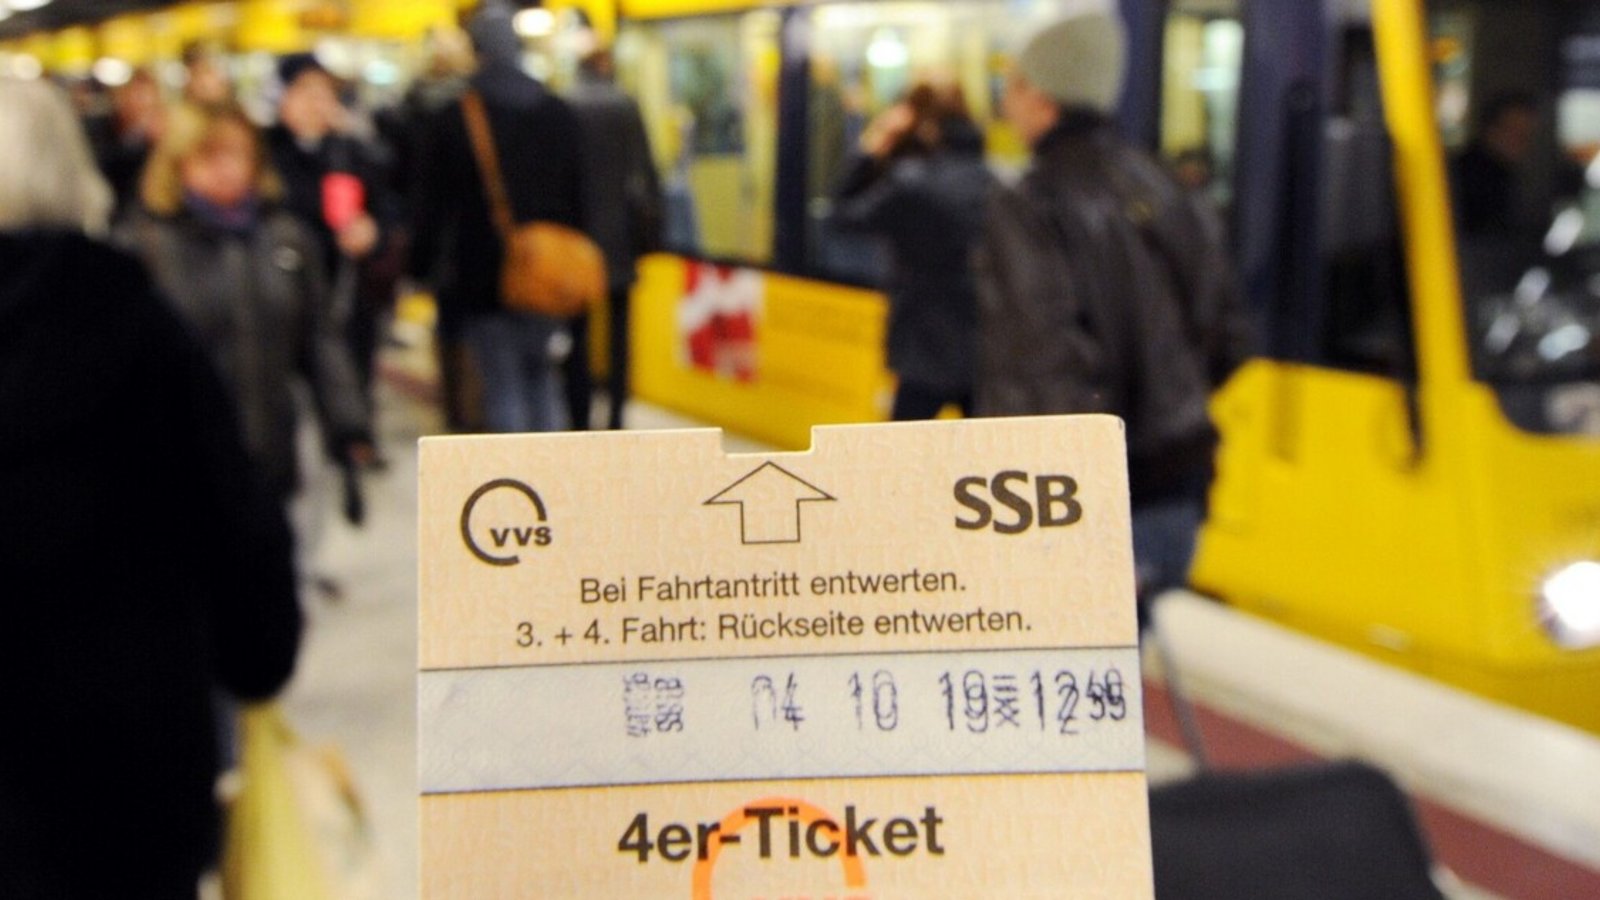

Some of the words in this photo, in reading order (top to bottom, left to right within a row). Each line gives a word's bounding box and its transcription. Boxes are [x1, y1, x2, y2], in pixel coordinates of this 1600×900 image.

[953, 470, 1083, 535] SSB
[580, 576, 626, 604] Bei
[638, 571, 800, 602] Fahrtantritt
[810, 568, 966, 596] entwerten.
[516, 621, 542, 648] 3.
[555, 627, 573, 645] +
[583, 618, 610, 645] 4.
[622, 616, 706, 644] Fahrt:
[719, 610, 864, 640] Rückseite
[874, 607, 1031, 635] entwerten.
[618, 805, 944, 861] 4er-Ticket
